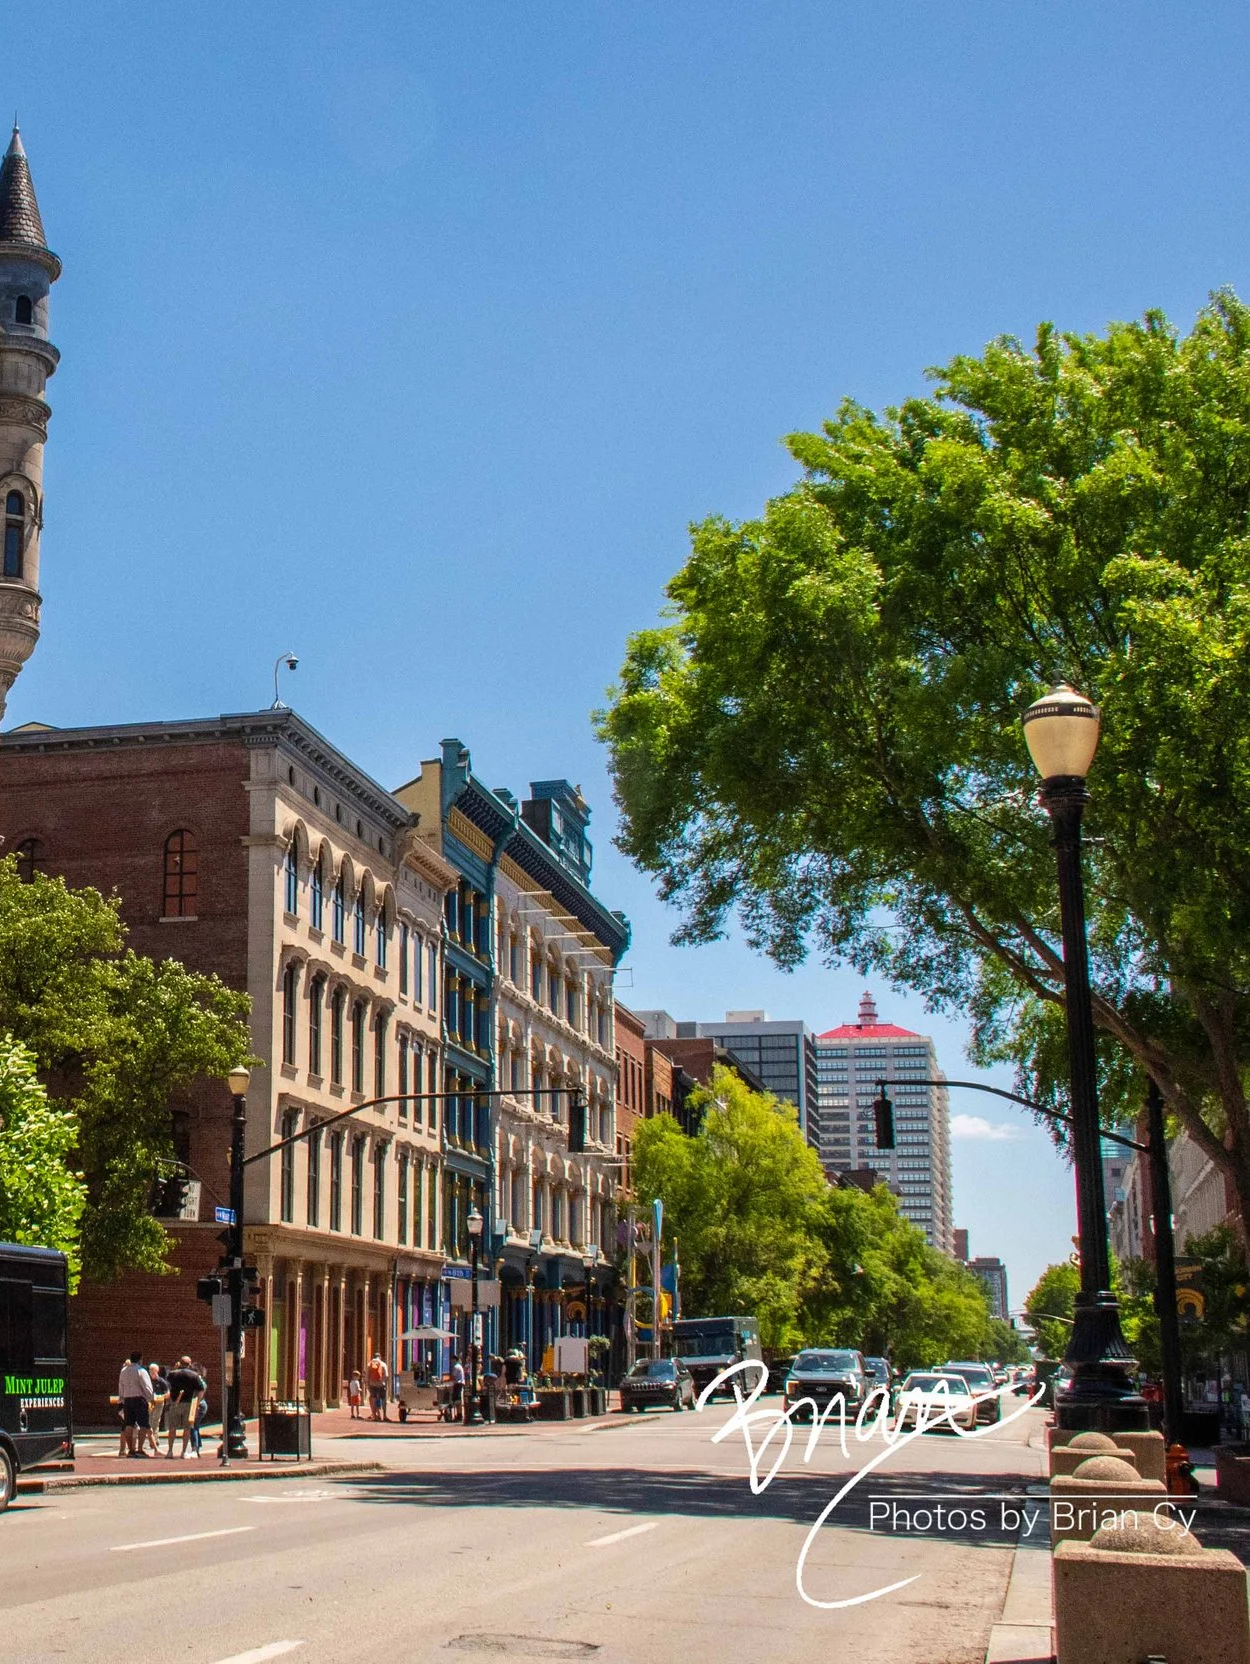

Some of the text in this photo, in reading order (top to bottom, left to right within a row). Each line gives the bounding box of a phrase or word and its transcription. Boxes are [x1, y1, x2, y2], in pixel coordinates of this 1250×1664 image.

[5, 1376, 64, 1394] MINT JULEP
[20, 1397, 65, 1408] EXPERIENCES
